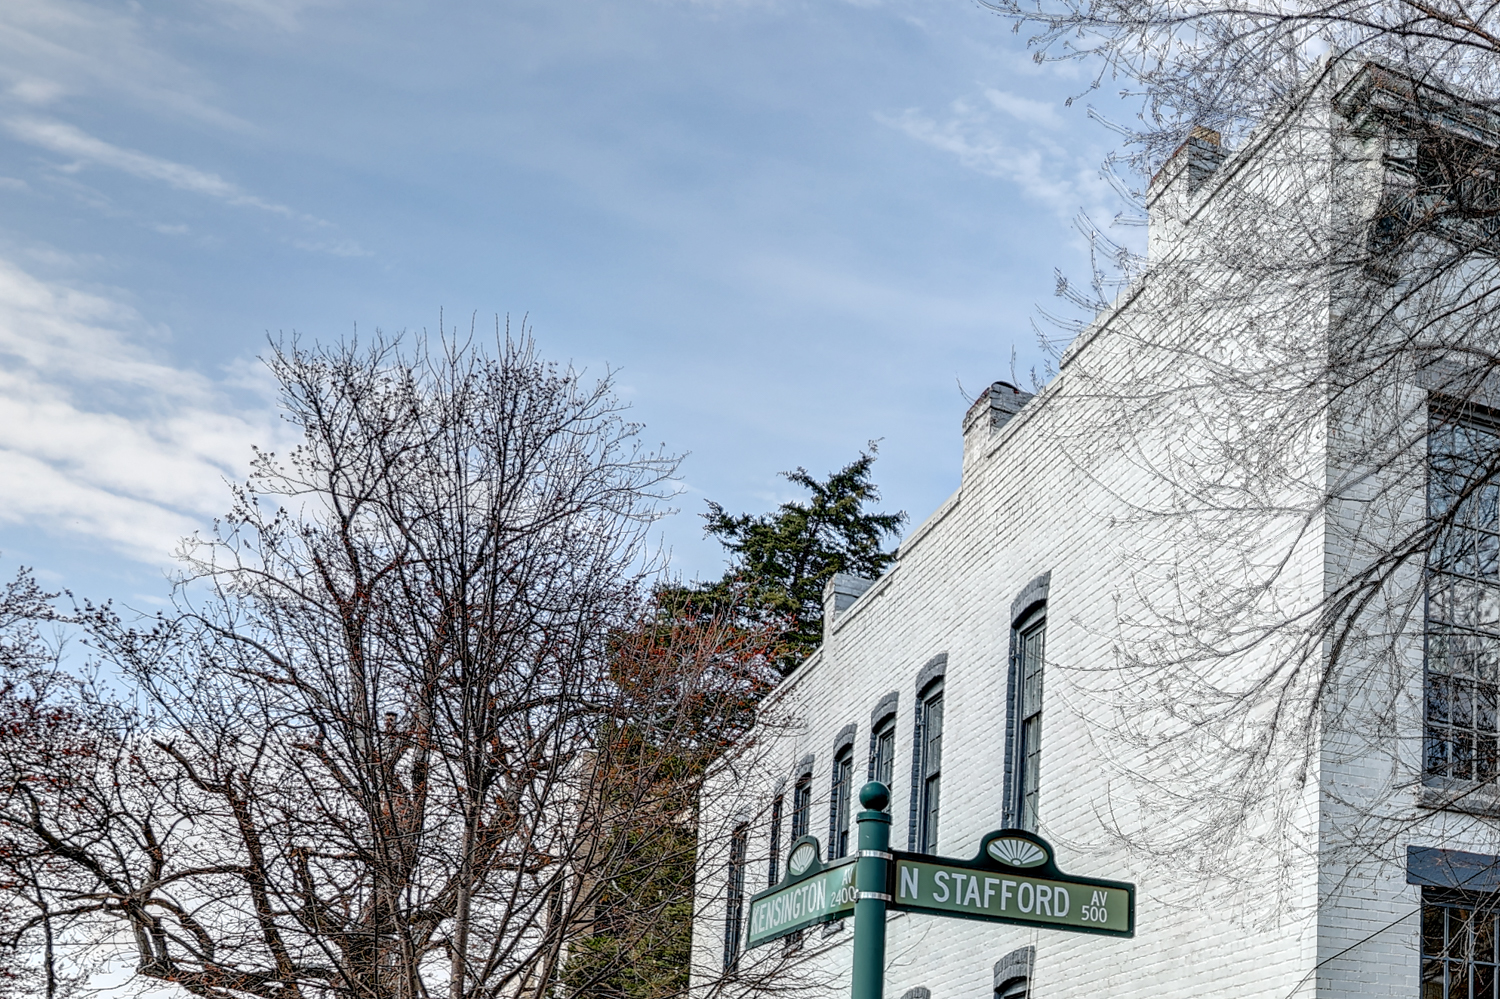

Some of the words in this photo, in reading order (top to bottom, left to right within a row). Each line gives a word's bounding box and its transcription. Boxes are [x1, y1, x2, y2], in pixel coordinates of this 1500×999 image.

[841, 867, 854, 886] AV
[830, 885, 856, 908] 2400
[900, 866, 919, 899] N
[932, 870, 1070, 918] STAFFORD
[1090, 890, 1107, 906] AV
[750, 878, 827, 937] KENSINGTON
[1081, 905, 1107, 924] 500
